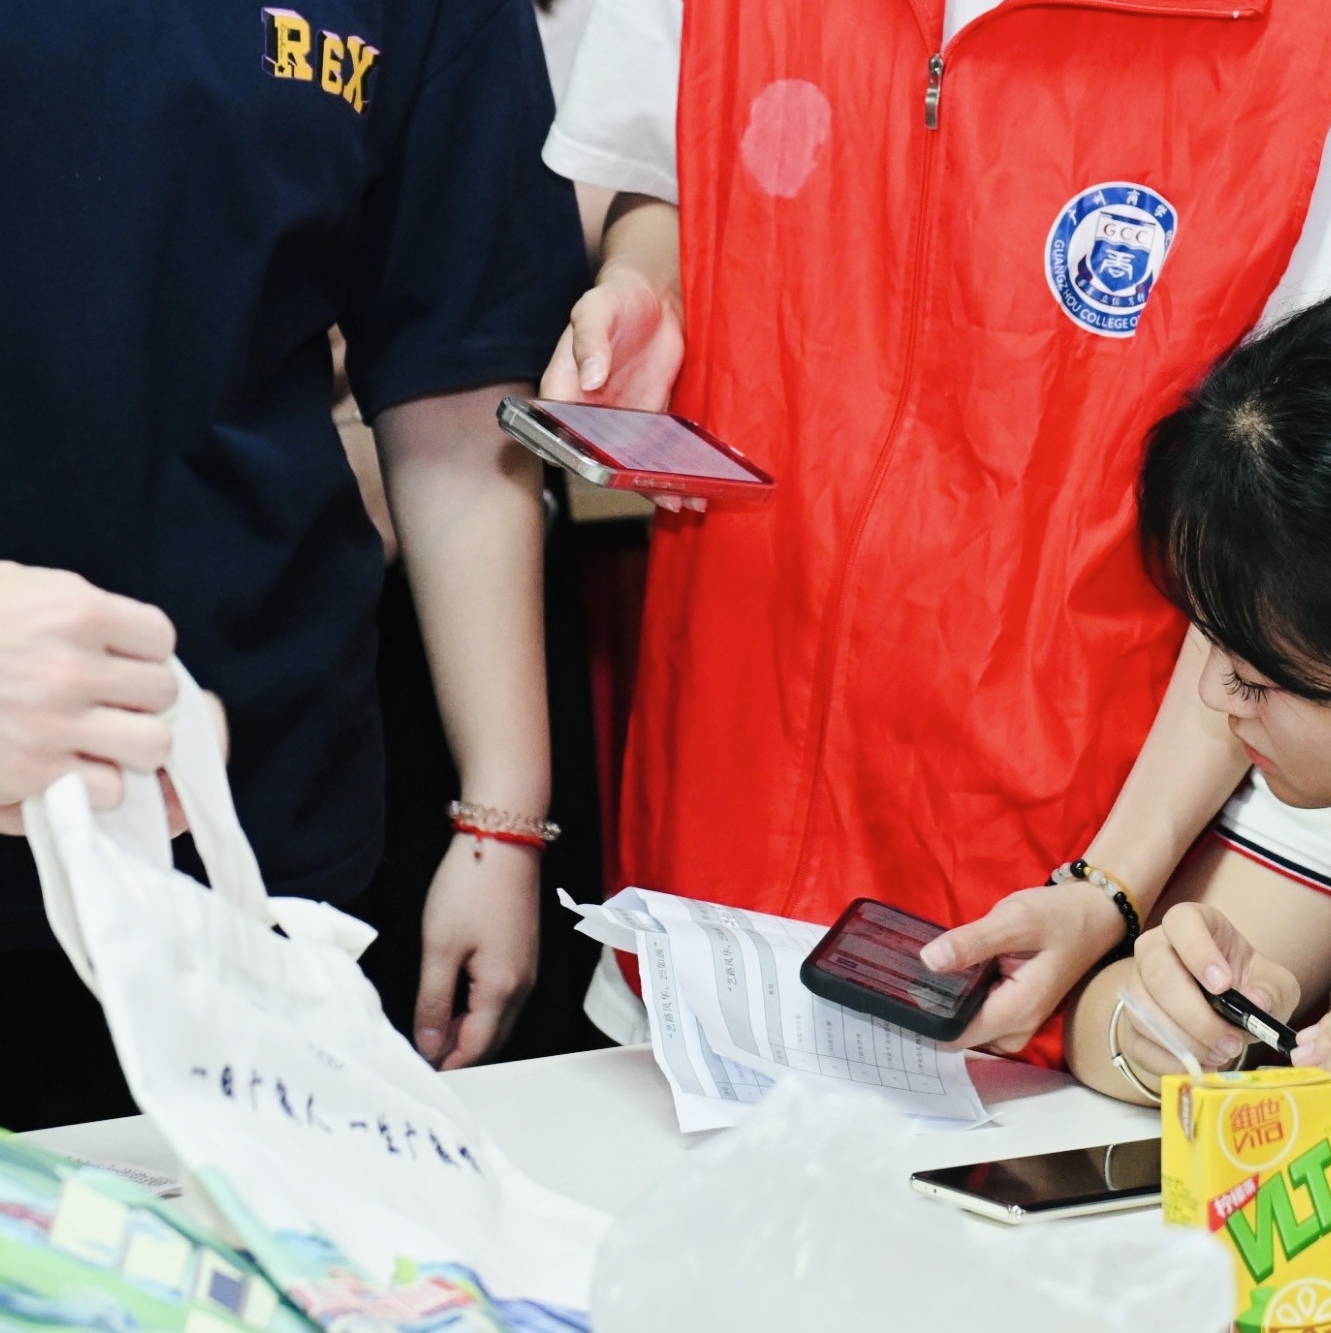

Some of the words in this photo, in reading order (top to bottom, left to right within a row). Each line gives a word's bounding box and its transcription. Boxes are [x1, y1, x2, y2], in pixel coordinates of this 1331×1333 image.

[262, 7, 380, 114] REX
[1103, 222, 1149, 245] GCC
[1052, 238, 1082, 313] GUANGZHOU
[1079, 308, 1130, 330] COLLEGE
